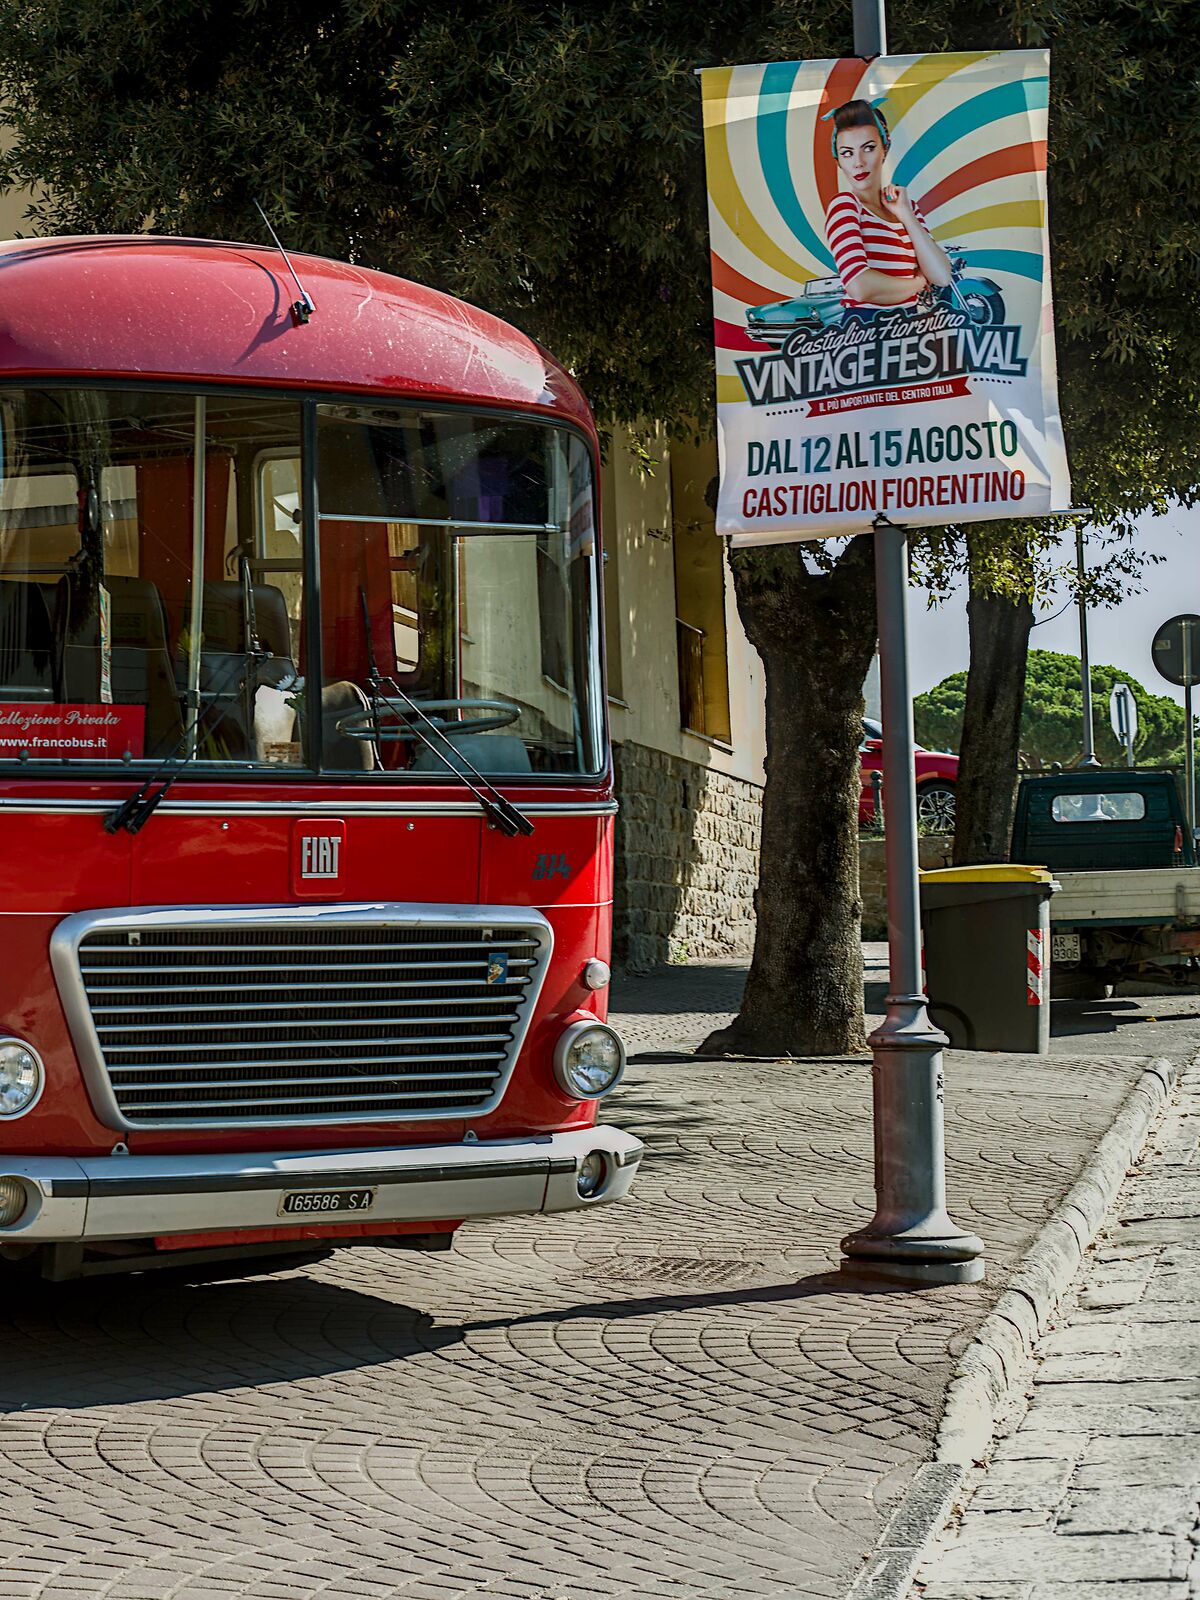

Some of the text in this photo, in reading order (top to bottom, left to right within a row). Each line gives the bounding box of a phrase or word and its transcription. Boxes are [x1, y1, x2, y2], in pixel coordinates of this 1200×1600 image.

[787, 307, 966, 358] Castiglion Fiorentino
[741, 326, 1022, 400] VINTAGE FESTIVAL
[818, 384, 954, 412] IL PIÙ IMPORTANTE DEL CENTRO ITALIA
[747, 419, 1018, 477] DAL 12 AL 15 AGOSTO
[742, 469, 1026, 518] CASTIGLION FIORENTINO
[64, 710, 121, 725] Privata
[301, 836, 342, 874] FIAT
[287, 1194, 341, 1211] 165586
